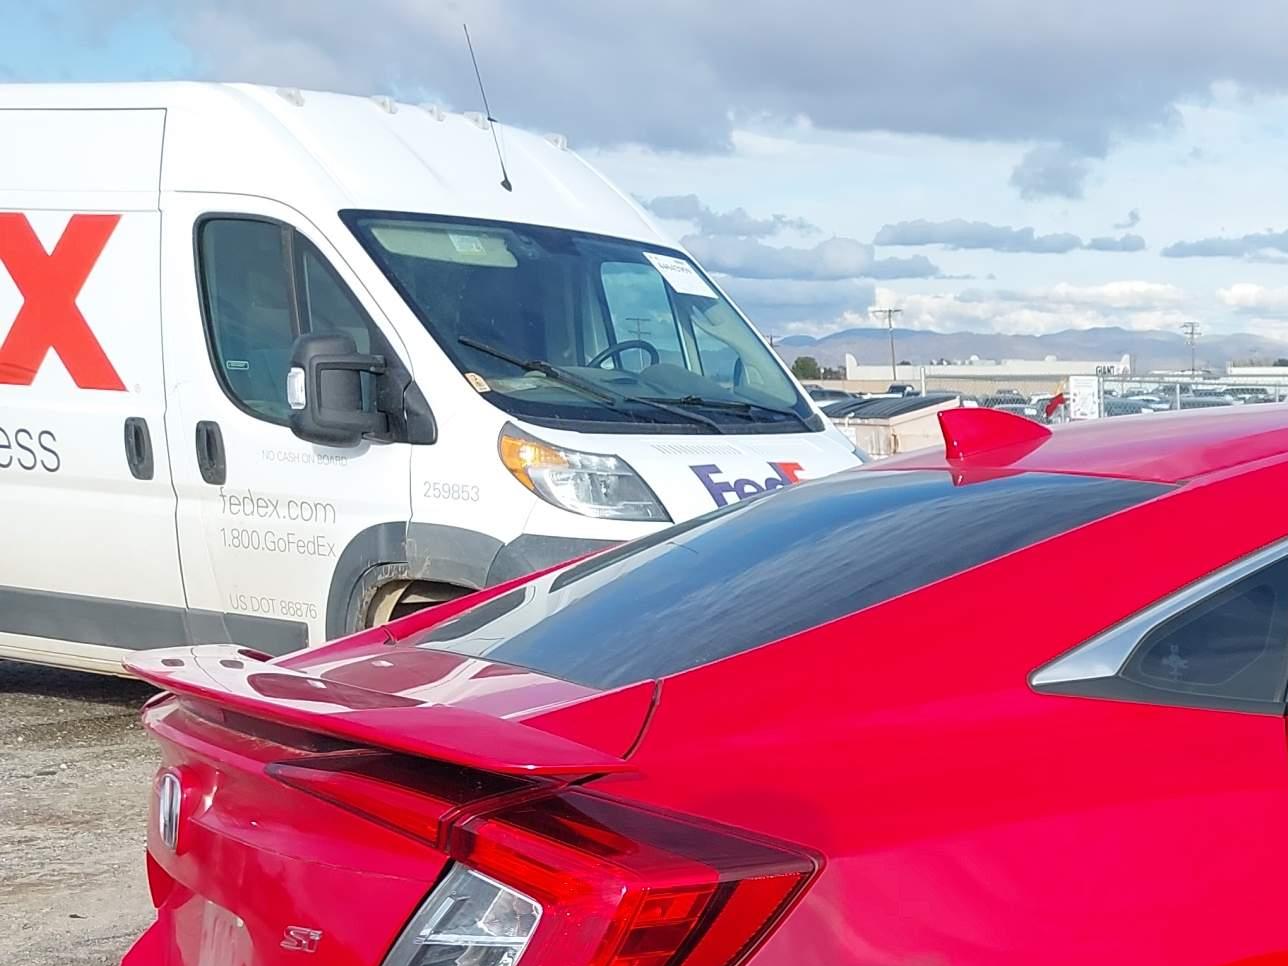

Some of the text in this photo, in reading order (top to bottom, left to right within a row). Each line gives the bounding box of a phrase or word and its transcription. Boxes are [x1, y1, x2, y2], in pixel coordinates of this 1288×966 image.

[261, 449, 348, 466] NO CASH ON BOARD
[423, 480, 480, 502] 259853
[219, 486, 337, 525] fedex.com
[220, 527, 337, 558] 1.800.GoFedEx
[230, 594, 318, 619] US DOT 86876
